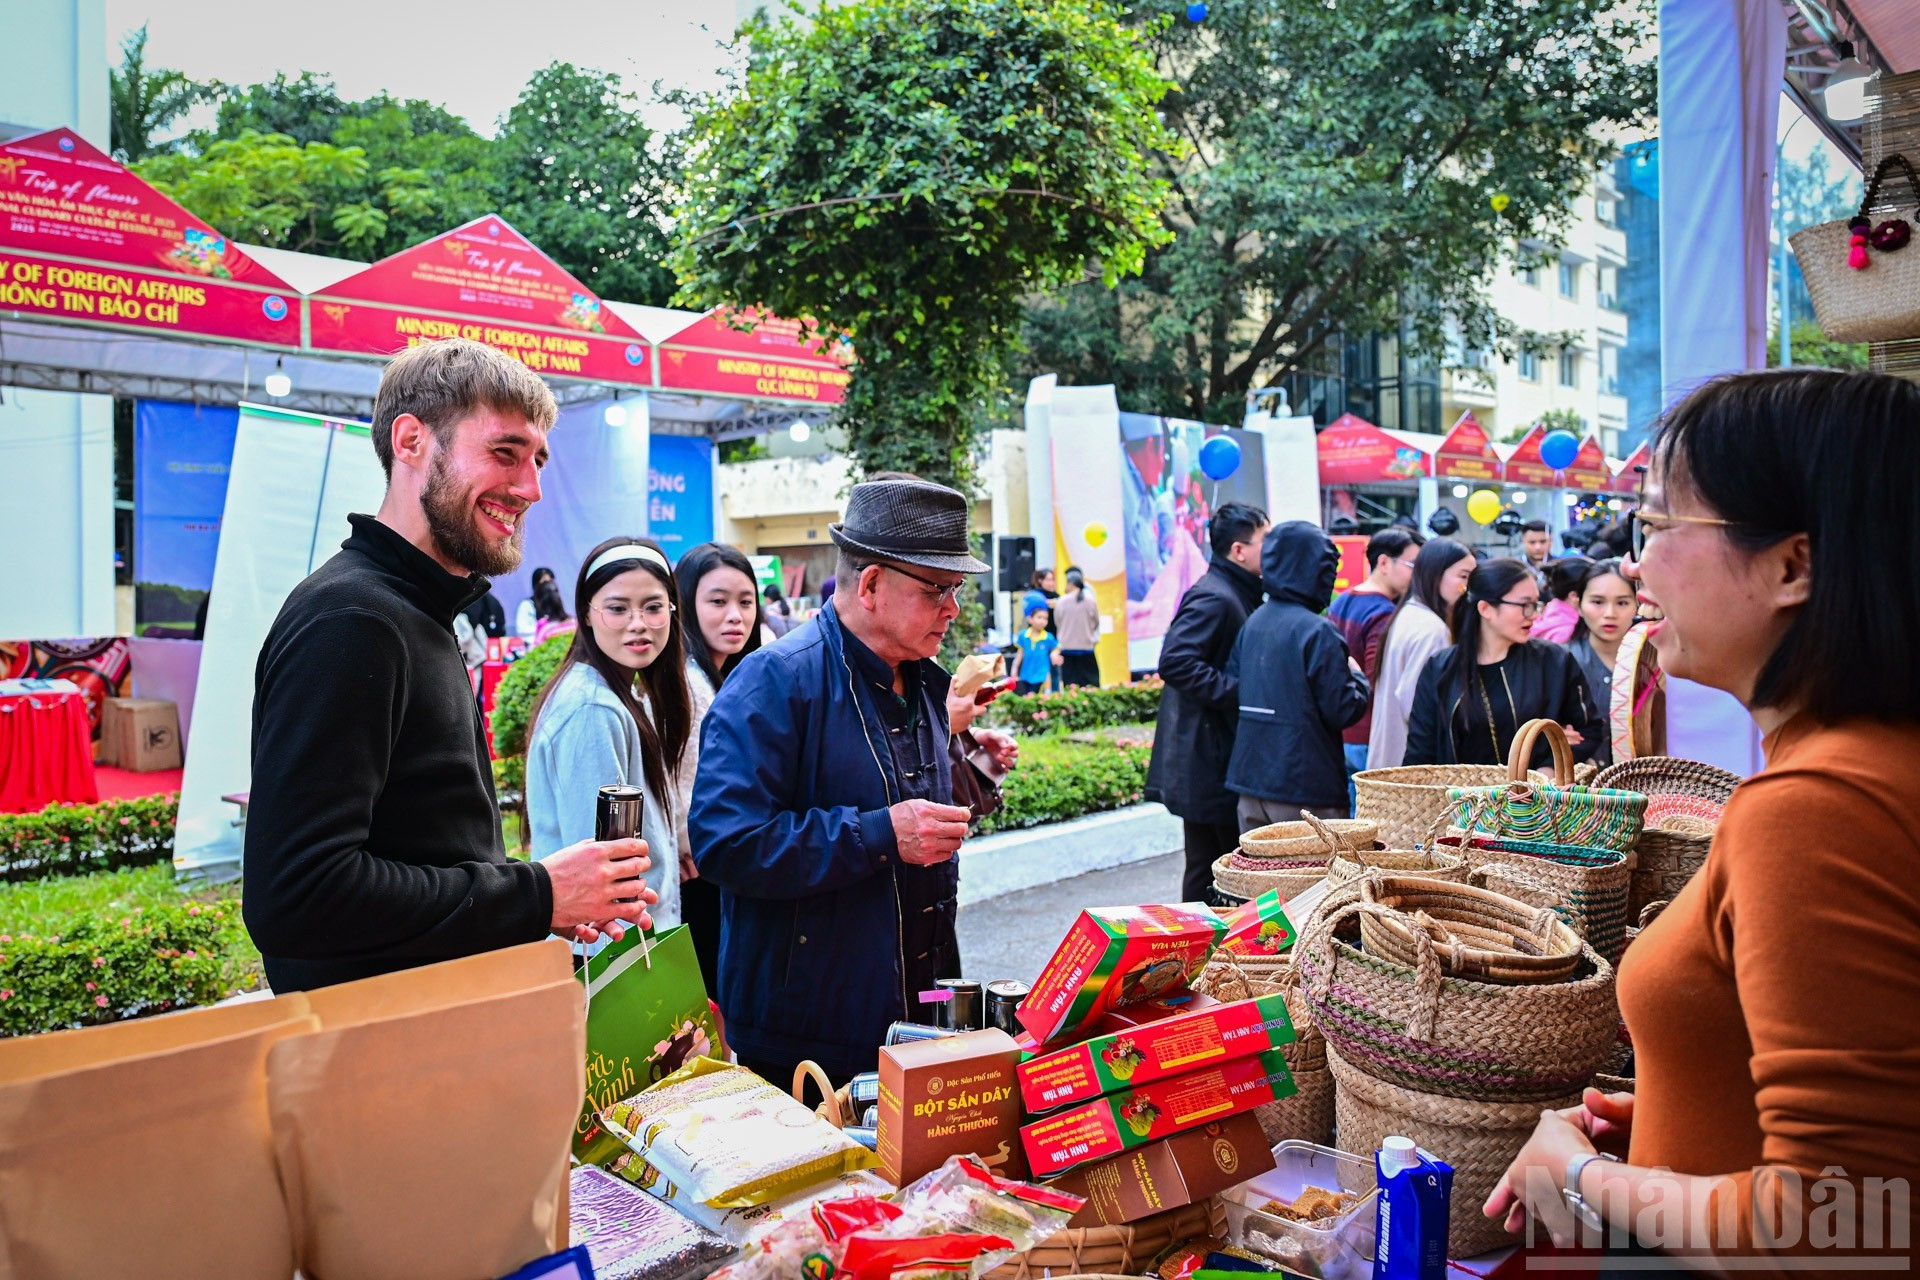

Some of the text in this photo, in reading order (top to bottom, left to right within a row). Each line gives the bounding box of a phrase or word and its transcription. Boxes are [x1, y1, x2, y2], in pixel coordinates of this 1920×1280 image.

[20, 169, 57, 192] Trip
[62, 180, 82, 198] of
[13, 262, 44, 283] OF
[47, 266, 132, 291] FOREIGN
[137, 279, 206, 306] AFFAIRS
[60, 291, 94, 313] TIN
[99, 295, 141, 319] BÁO
[145, 303, 179, 324] CHÍ
[396, 316, 461, 337] MINISTRY
[462, 324, 483, 341] OF
[484, 327, 541, 350] FOREIGN
[542, 336, 589, 356] AFFAIRS
[551, 355, 581, 373] NAM
[1065, 966, 1082, 990] ANH
[1049, 990, 1067, 1012] TÁM
[1264, 1016, 1285, 1031] BÁNH
[1221, 1029, 1236, 1040] TÁM
[1236, 1026, 1250, 1036] ANH
[973, 1072, 985, 1082] Phố
[1267, 1070, 1287, 1084] BÁNH
[1057, 1084, 1072, 1096] ANH
[1229, 1084, 1243, 1094] TÁM
[1242, 1080, 1255, 1090] ANH
[913, 1086, 1010, 1116] BỘT SẮN DÂY
[1042, 1089, 1057, 1101] TÁM
[927, 1124, 955, 1137] HÀNG
[1050, 1149, 1069, 1162] TÁM
[1069, 1143, 1088, 1156] ANH
[1137, 1152, 1162, 1208] BỘT SẮN DÂY
[1378, 1198, 1391, 1263] Vinamilk
